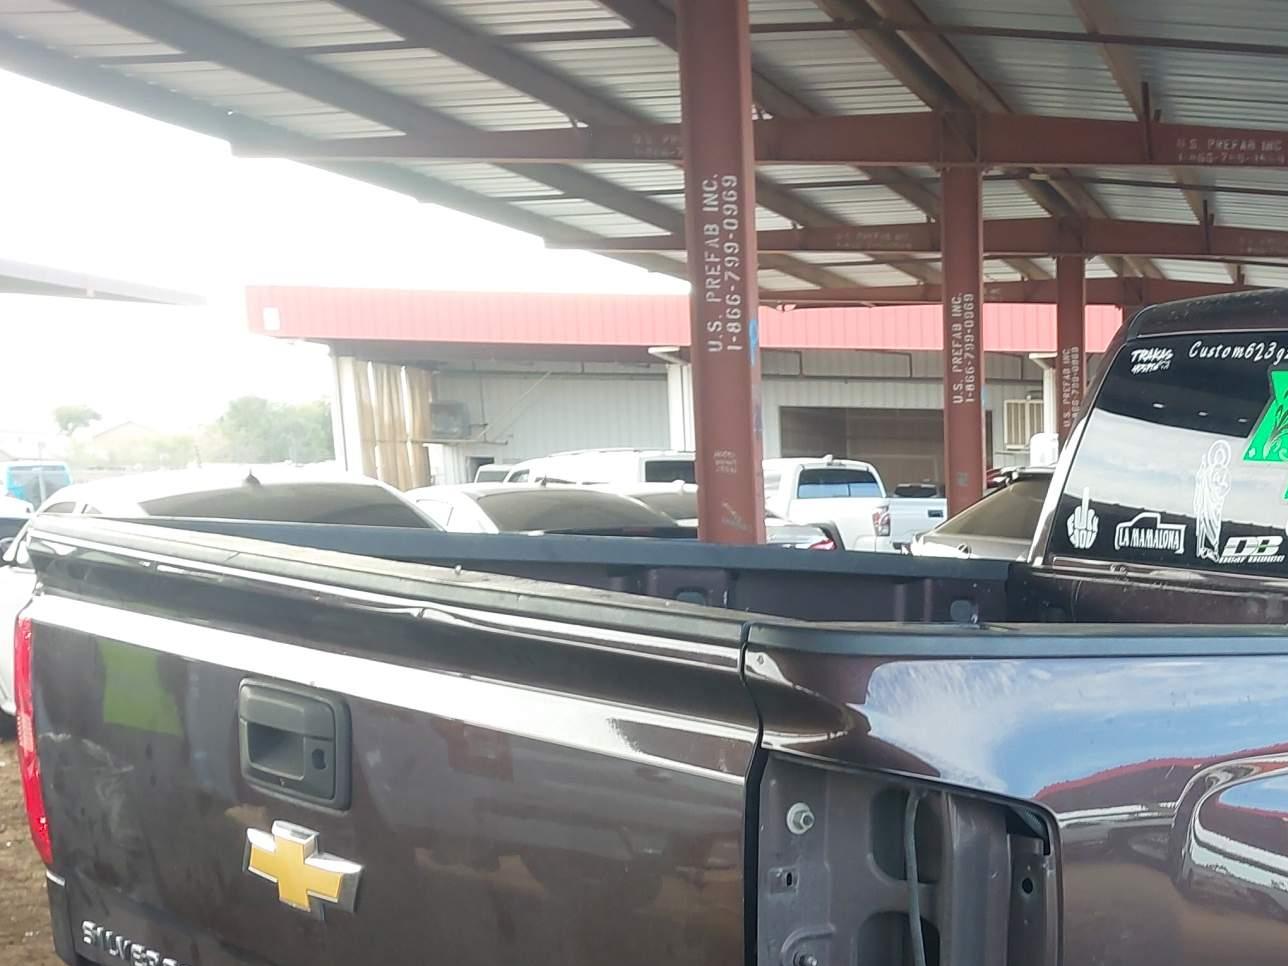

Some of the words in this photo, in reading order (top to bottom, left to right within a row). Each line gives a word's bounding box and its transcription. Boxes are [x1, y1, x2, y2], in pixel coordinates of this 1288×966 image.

[702, 174, 720, 212] INC.
[704, 223, 721, 303] PREFAB
[722, 175, 743, 351] 1-866-799-0969
[707, 314, 722, 352] U.S.
[952, 323, 964, 373] PREFAB
[1131, 347, 1174, 363] TRAKAS
[1118, 527, 1132, 548] LA
